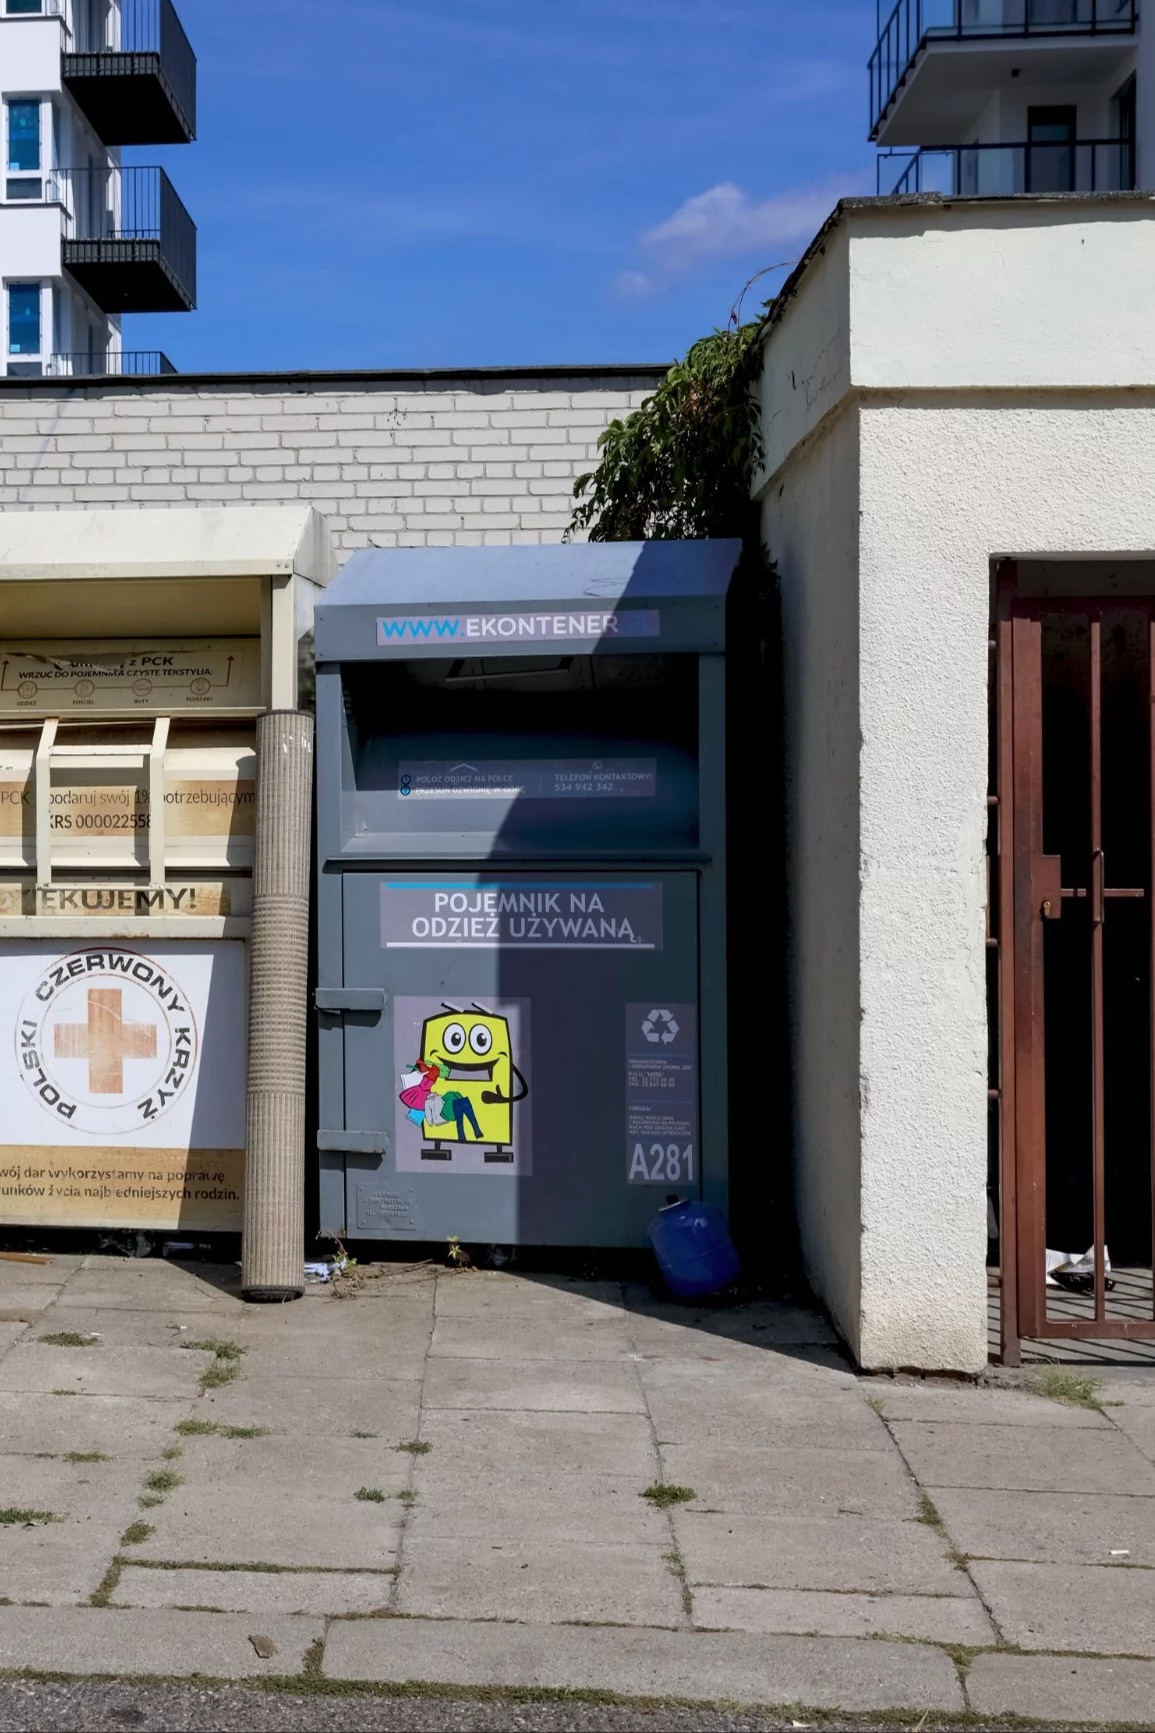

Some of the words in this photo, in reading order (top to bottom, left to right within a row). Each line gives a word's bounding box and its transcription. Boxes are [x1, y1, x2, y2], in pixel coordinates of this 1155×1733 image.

[141, 656, 173, 666] PCK
[18, 671, 52, 679] WRZUĆ
[163, 668, 213, 676] TEKSTYLIA:
[474, 775, 485, 783] NA
[555, 773, 591, 781] TELEFON
[555, 783, 571, 791] 534
[576, 783, 592, 791] 942
[596, 782, 613, 791] 342
[1, 790, 29, 804] PCK
[100, 790, 130, 808] swój
[164, 788, 255, 808] otrzebującym
[434, 893, 560, 913] POJEMNIK
[570, 892, 605, 913] NA
[412, 912, 500, 938] ODZIEŻ
[510, 912, 636, 943] UŻYWANĄ
[35, 953, 185, 1013] CZERWONY
[20, 1020, 77, 1119] POLSKI
[136, 1027, 191, 1120] KRZYŻ
[628, 1143, 694, 1181] A281
[24, 1167, 45, 1178] dar
[49, 1167, 144, 1182] wykorzystamy
[148, 1170, 163, 1181] na
[167, 1170, 225, 1184] poprawę
[48, 1185, 80, 1198] życia
[195, 1188, 240, 1201] rodzin.
